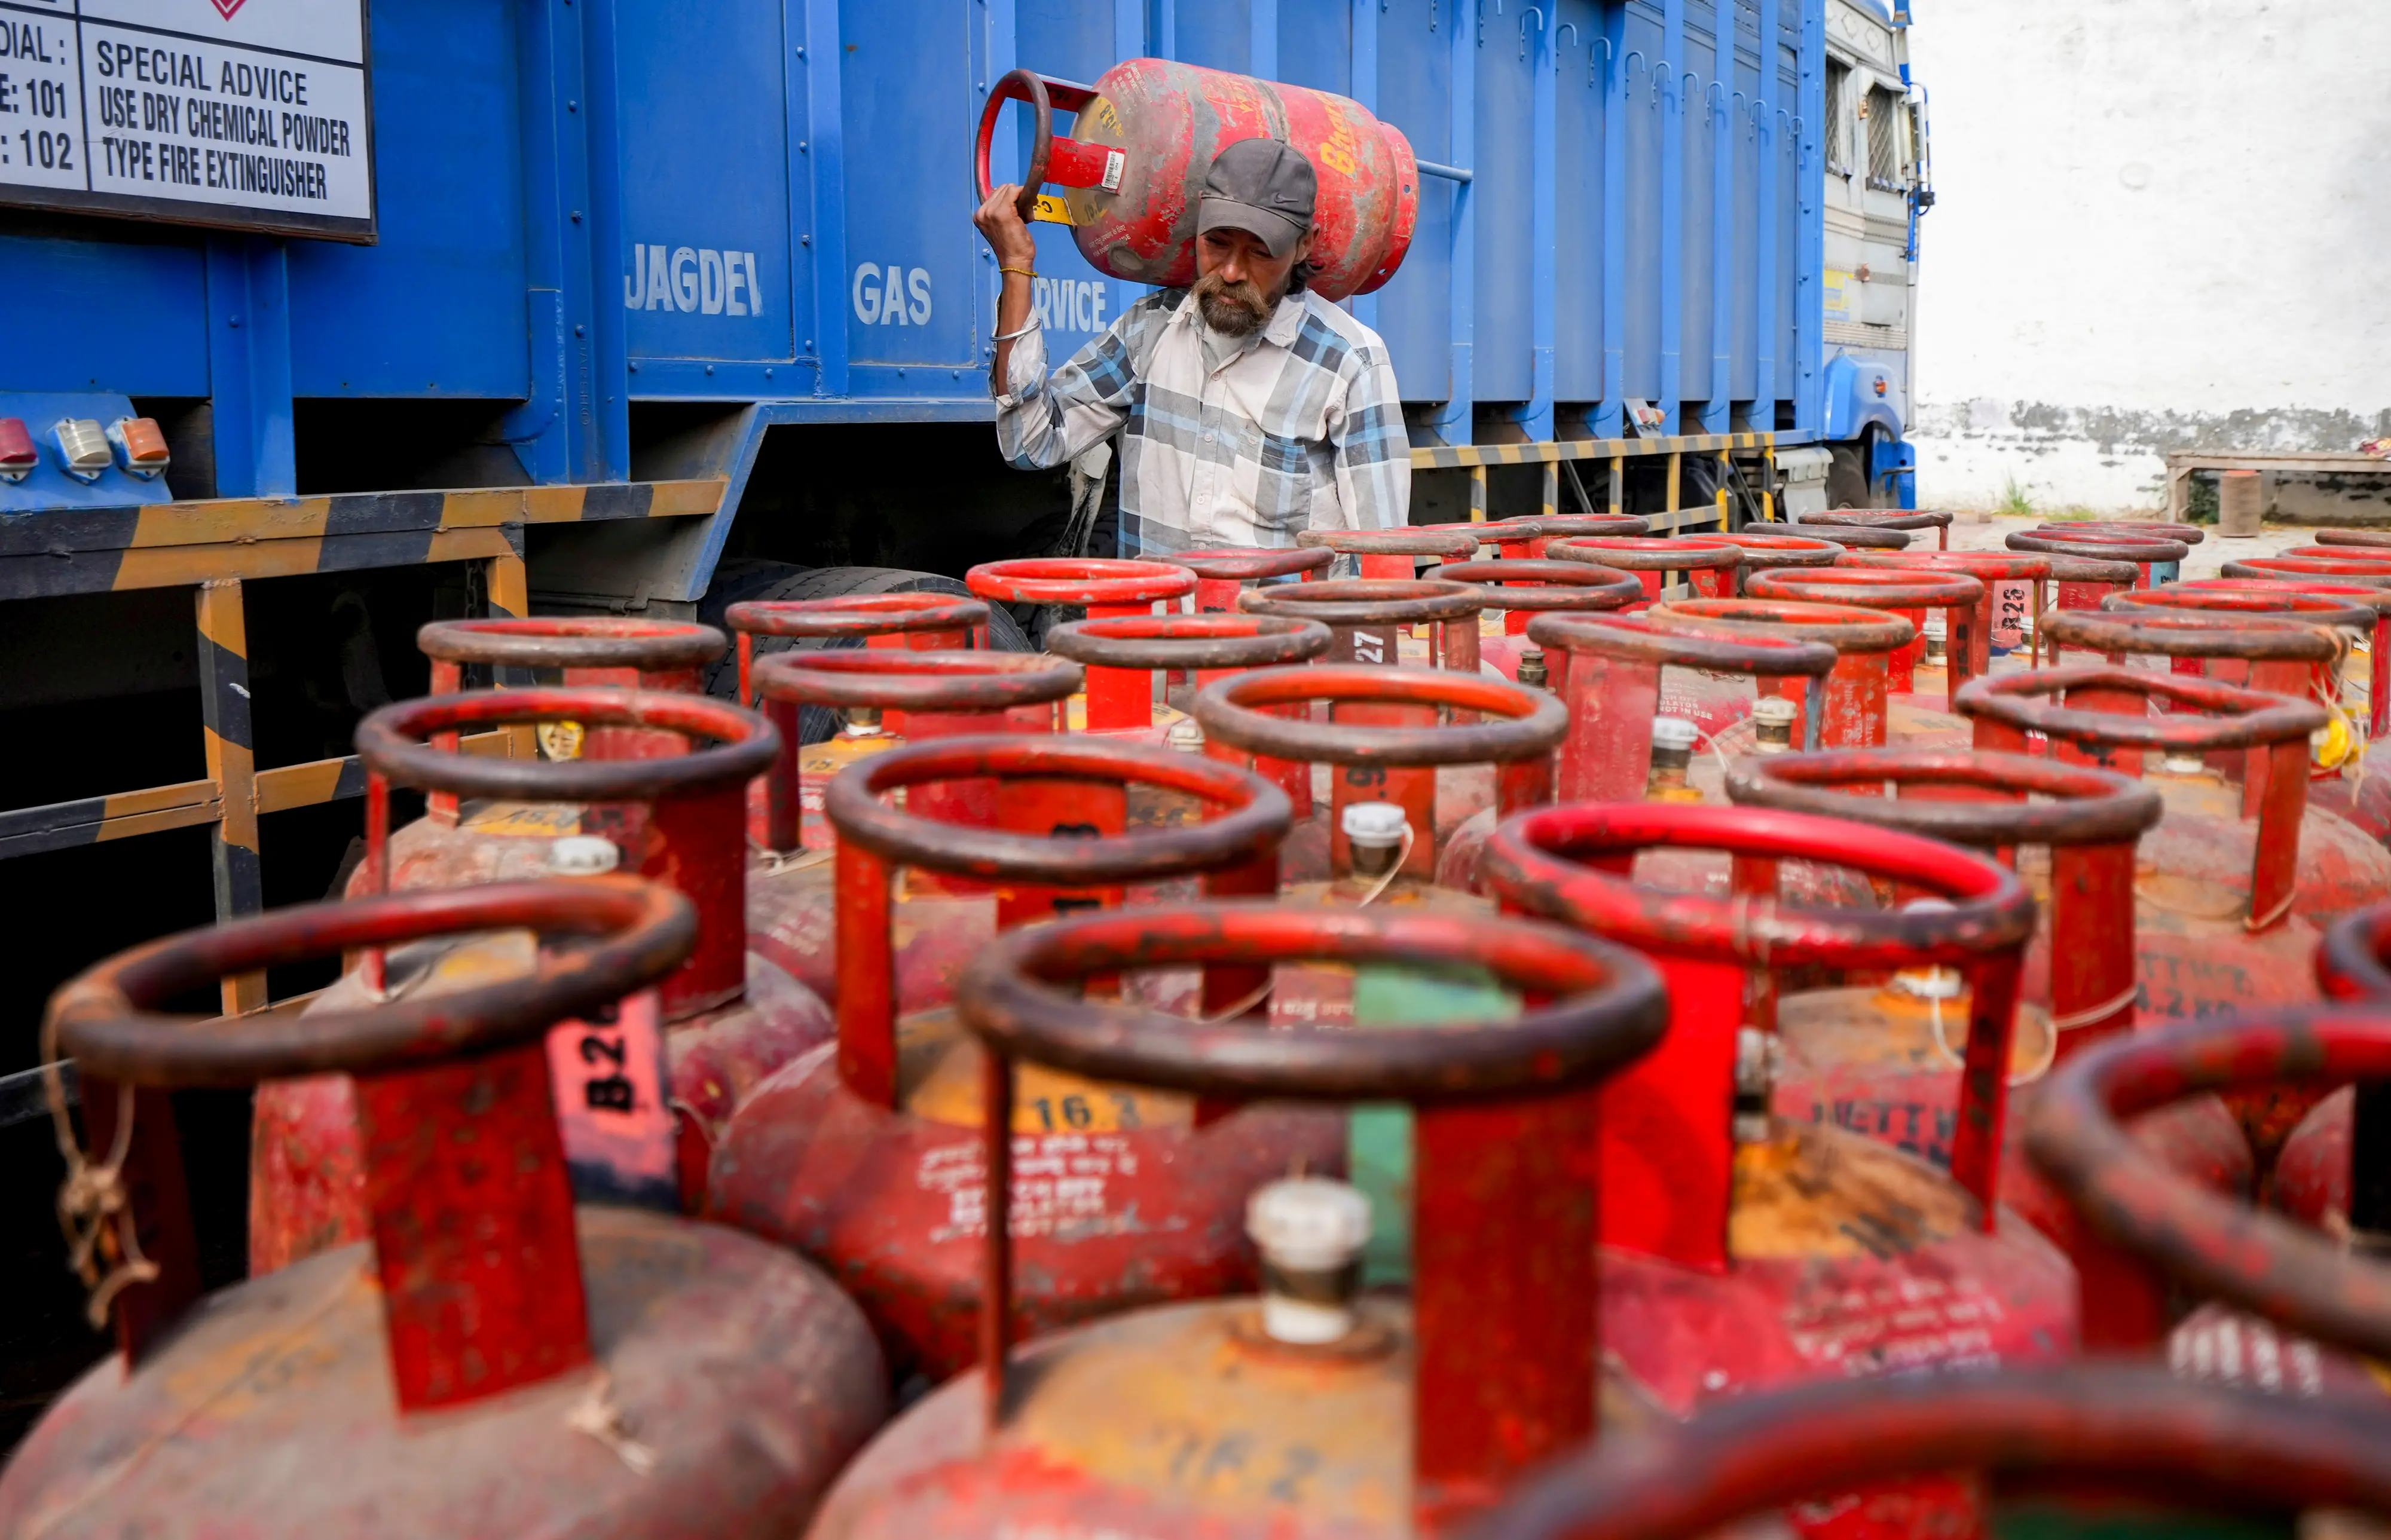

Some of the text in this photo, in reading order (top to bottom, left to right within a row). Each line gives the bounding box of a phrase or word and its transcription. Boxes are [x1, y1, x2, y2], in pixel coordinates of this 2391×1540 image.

[26, 78, 66, 120] 101
[97, 39, 308, 106] SPECIAL ADVICE
[99, 85, 351, 157] USE DRY CHEMICAL POWDER
[20, 129, 73, 170] 102
[102, 136, 327, 200] TYPE FIRE EXTINGUISHER
[853, 262, 1106, 332] GAS RVICE
[1353, 631, 1384, 663] 27
[1693, 710, 1713, 720] USE
